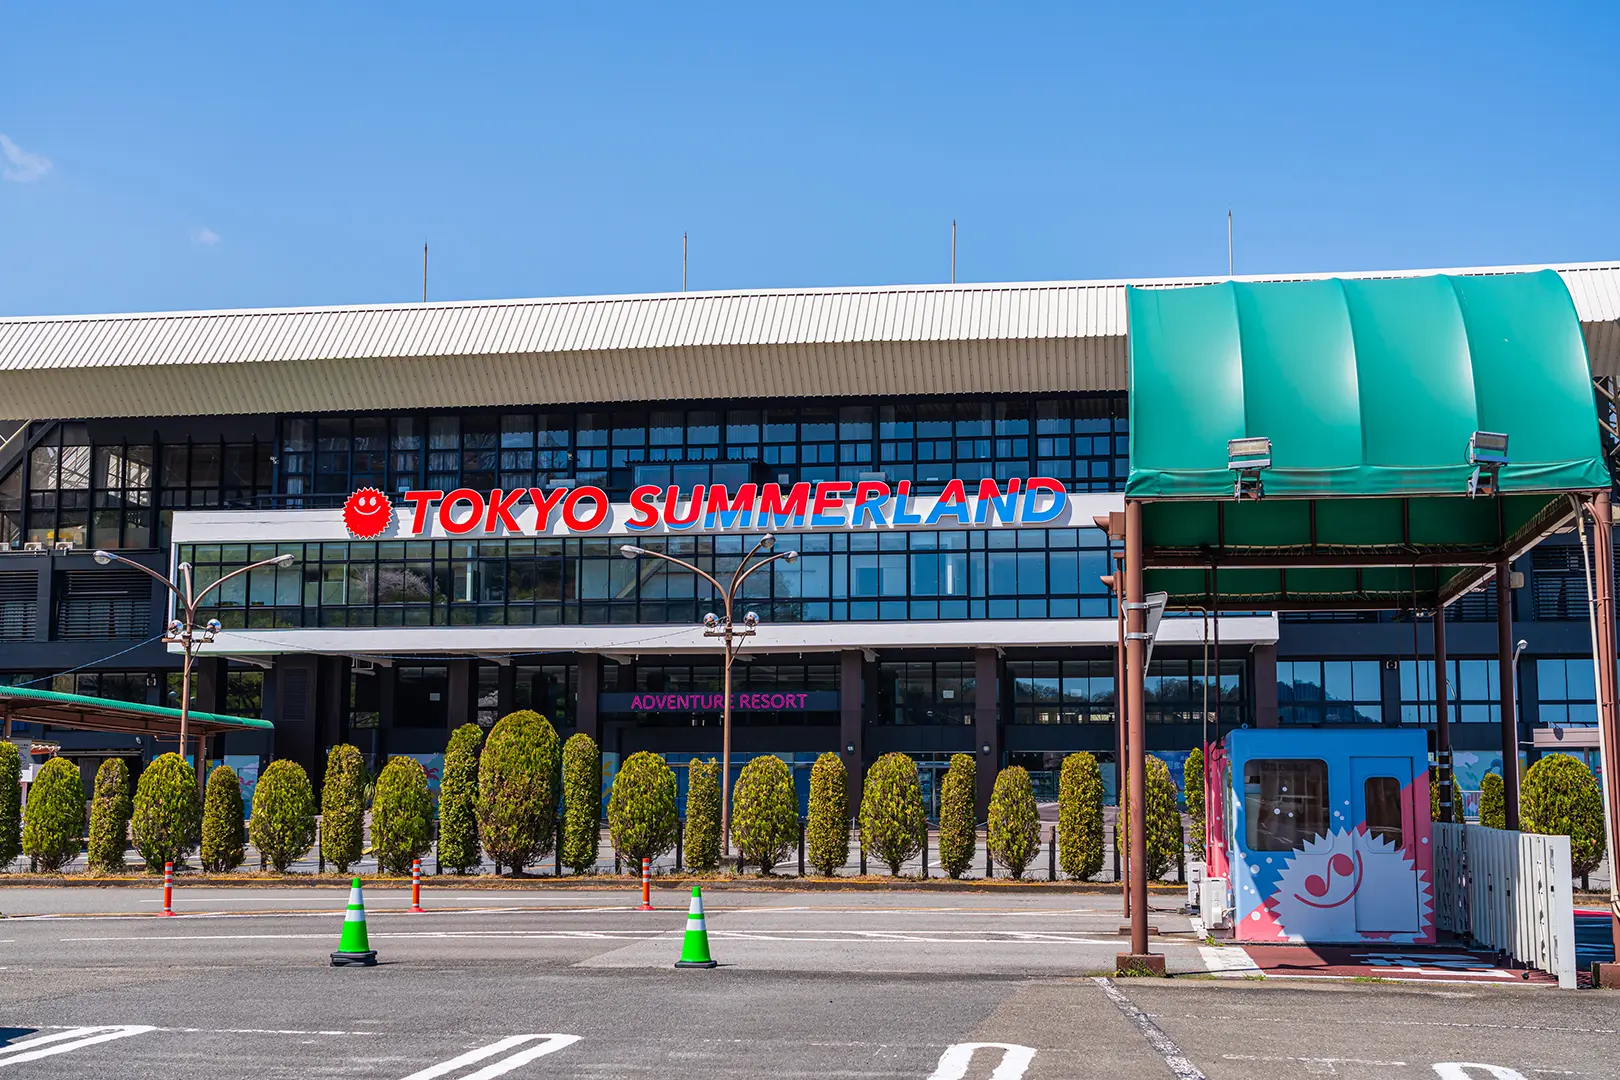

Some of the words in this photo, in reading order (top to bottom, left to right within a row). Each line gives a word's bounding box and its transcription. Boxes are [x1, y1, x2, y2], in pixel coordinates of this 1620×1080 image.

[404, 485, 609, 535] TOKYO
[624, 477, 1068, 531] SUMMERLAND
[739, 693, 808, 709] RESORT
